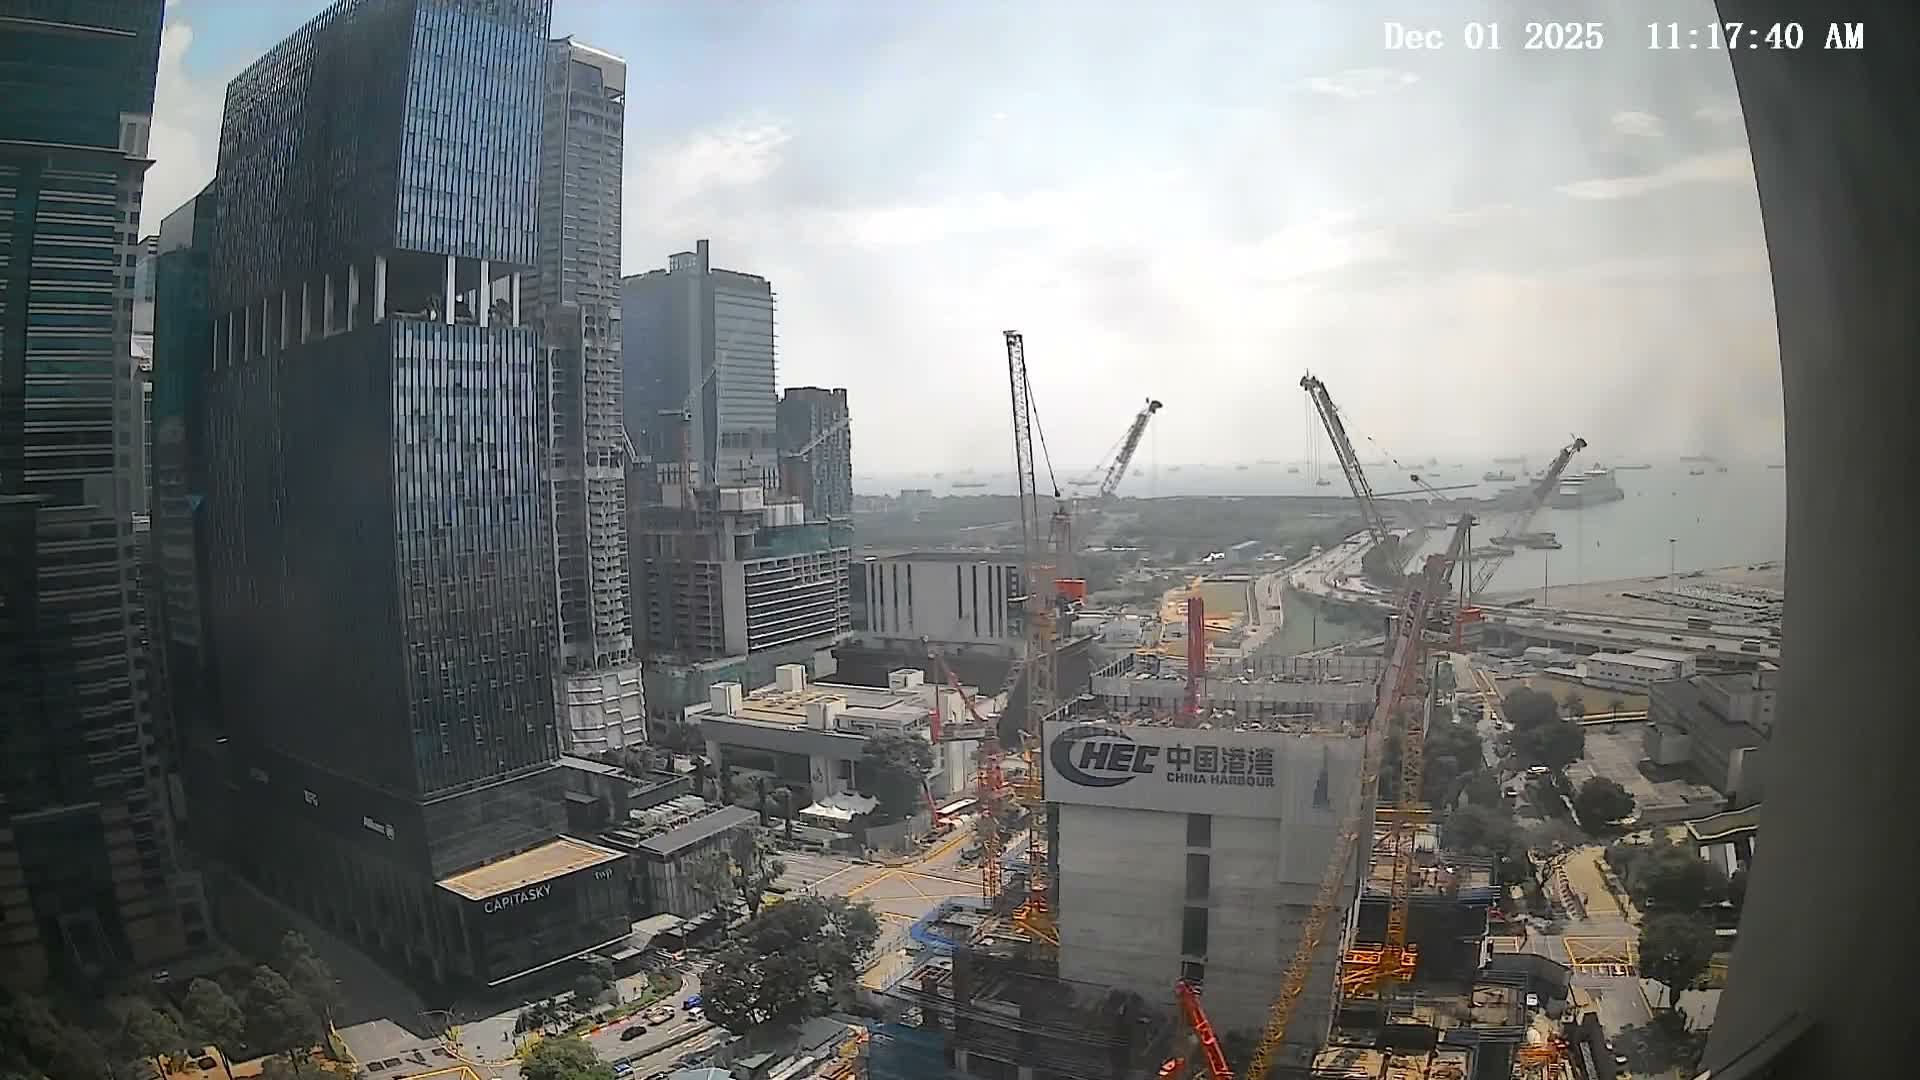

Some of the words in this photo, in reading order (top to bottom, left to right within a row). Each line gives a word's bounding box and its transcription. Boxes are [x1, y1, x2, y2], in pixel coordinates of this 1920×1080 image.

[1167, 742, 1274, 775] 中国港湾
[1167, 772, 1206, 785] CHINA
[1210, 774, 1275, 787] HARBOUR
[484, 884, 552, 914] CAPITASKY
